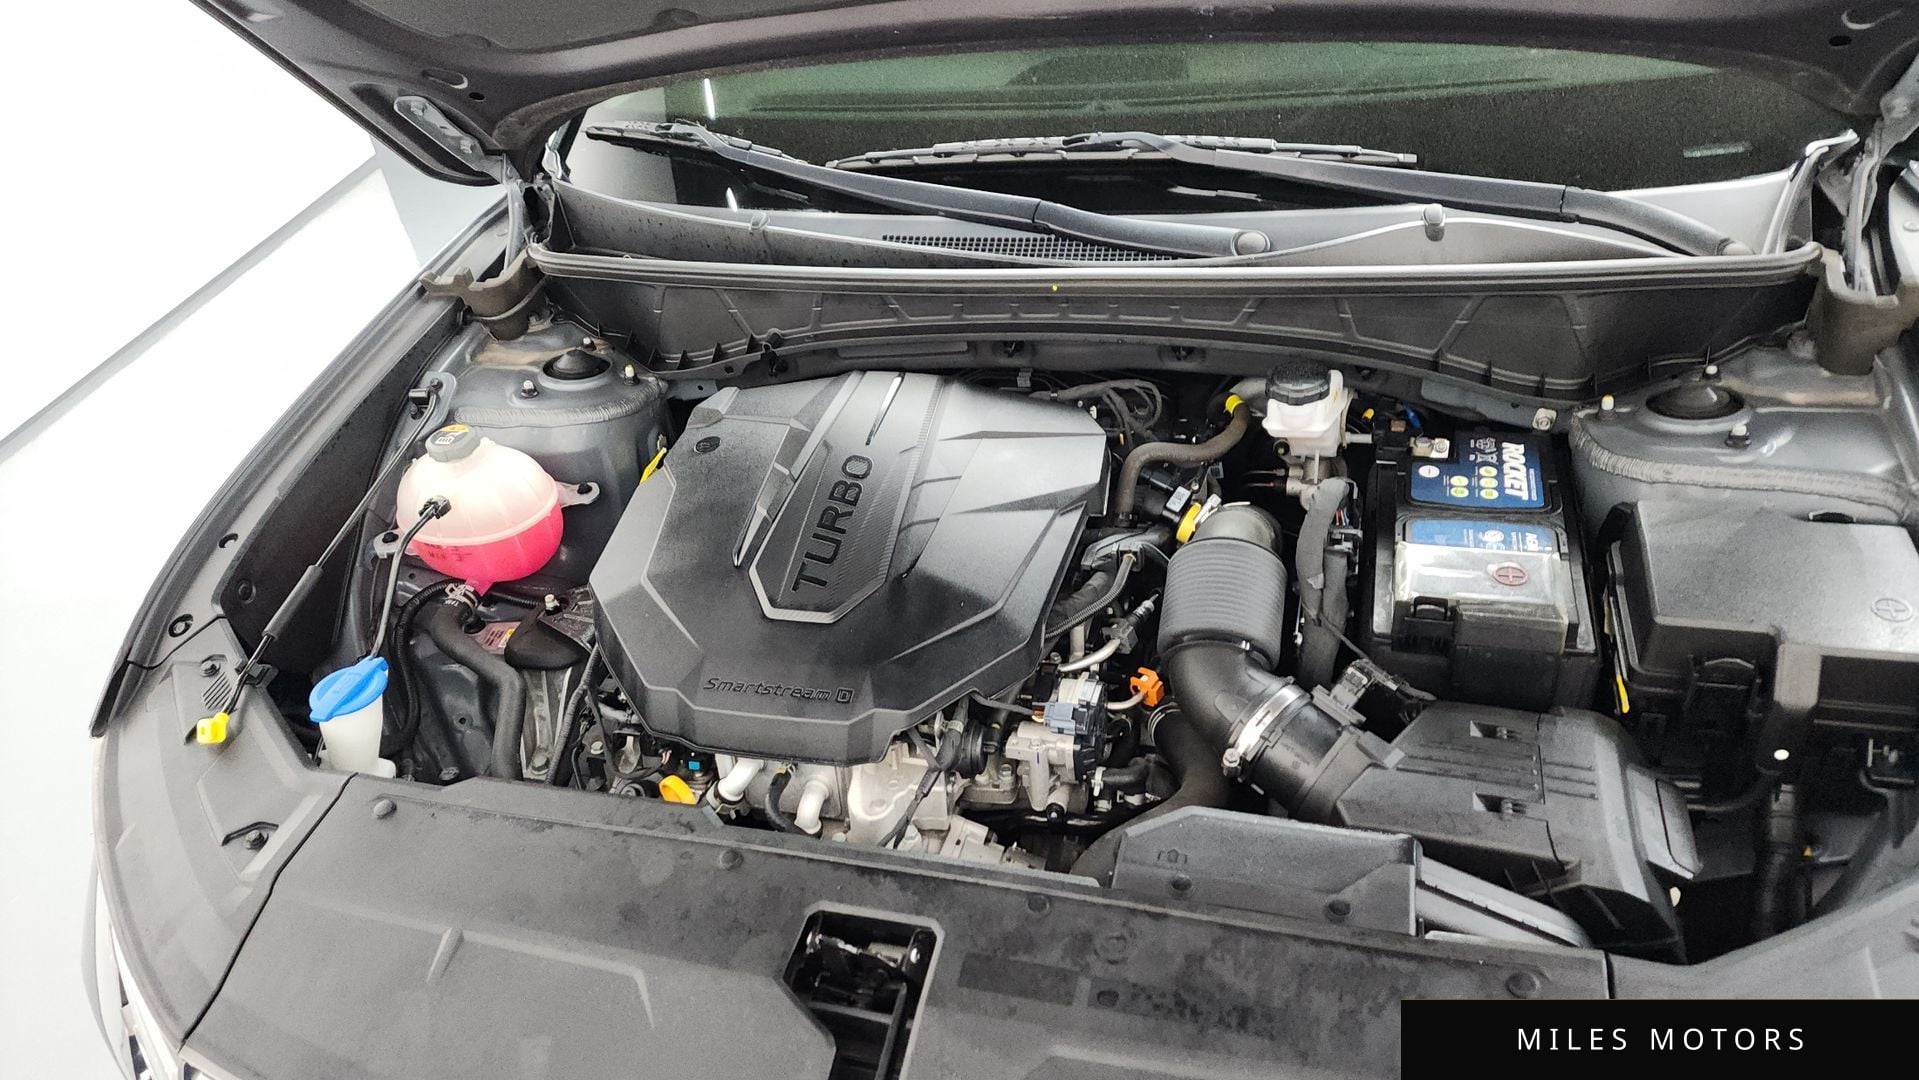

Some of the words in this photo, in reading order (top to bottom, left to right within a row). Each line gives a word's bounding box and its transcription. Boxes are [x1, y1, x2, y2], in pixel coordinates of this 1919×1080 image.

[1502, 441, 1529, 500] ROCKET
[792, 454, 873, 592] TURBO
[703, 677, 831, 700] Smartstream
